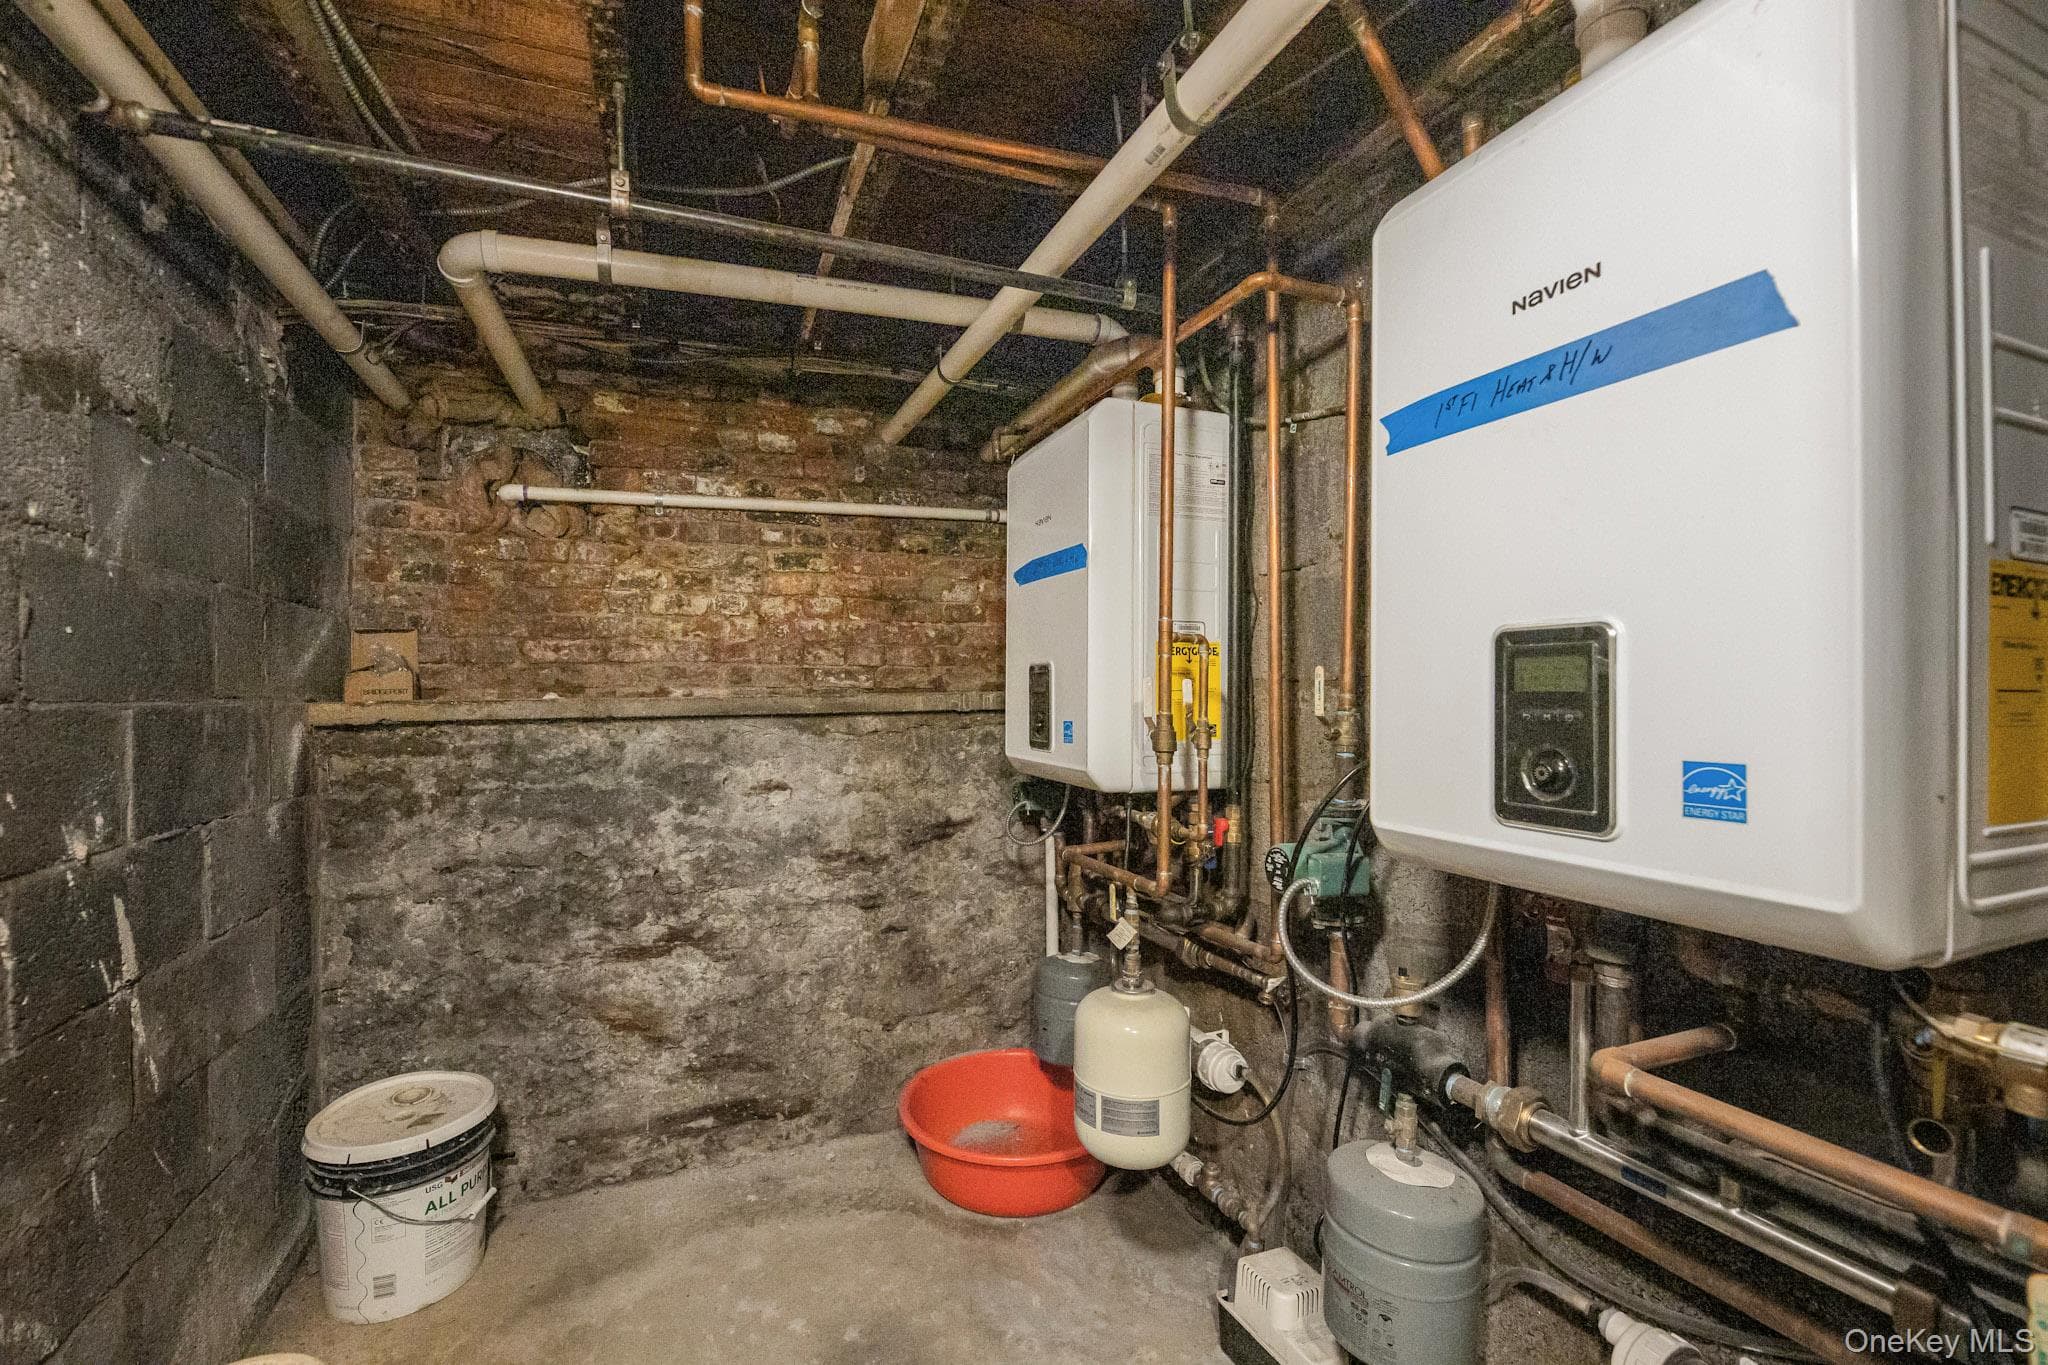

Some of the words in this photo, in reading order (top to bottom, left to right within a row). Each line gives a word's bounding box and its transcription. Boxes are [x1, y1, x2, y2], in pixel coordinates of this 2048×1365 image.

[1559, 339, 1614, 386] H/W
[1684, 806, 1719, 819] ENERGY
[1720, 809, 1746, 821] STAR
[425, 1181, 444, 1194] USG
[424, 1191, 457, 1216] ALL
